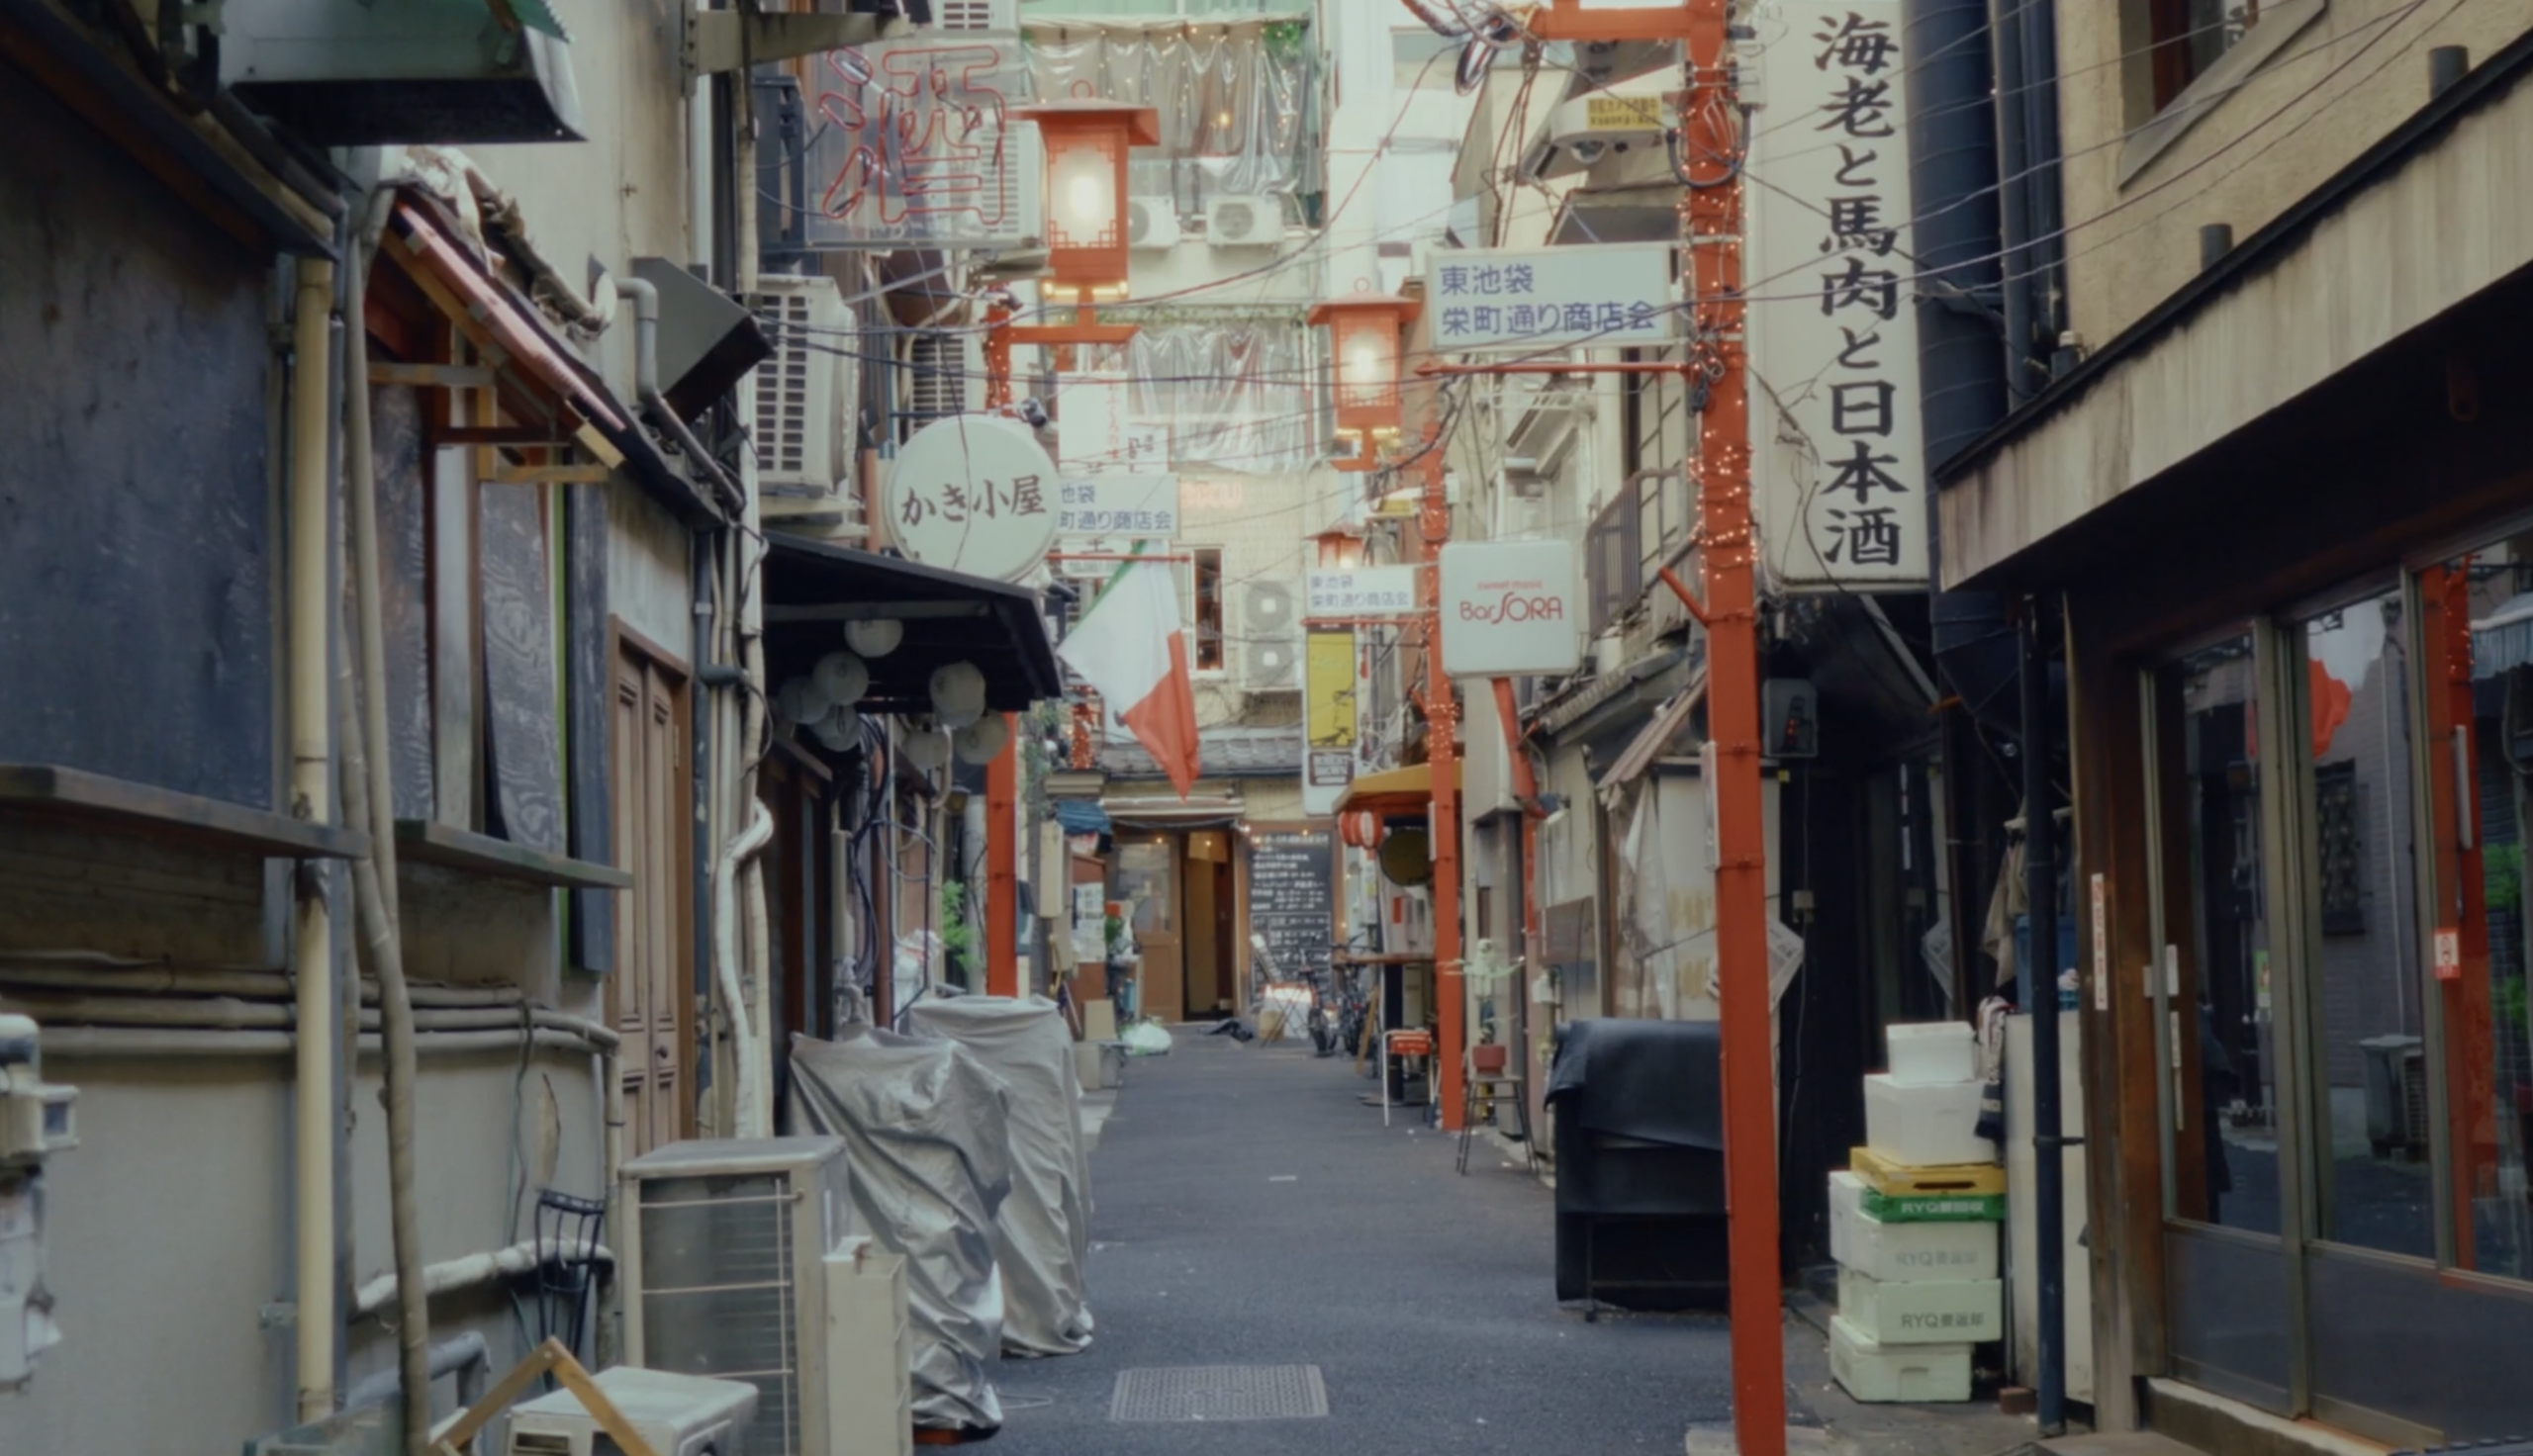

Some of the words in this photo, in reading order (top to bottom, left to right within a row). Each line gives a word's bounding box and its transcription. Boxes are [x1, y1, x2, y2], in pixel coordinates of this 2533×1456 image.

[819, 45, 1005, 226] 酒
[1440, 263, 1534, 296] 東池袋
[1812, 11, 1910, 566] 海老と馬肉と日本酒
[1442, 300, 1656, 336] 栄町通り商店会
[901, 474, 1047, 527] かき小屋
